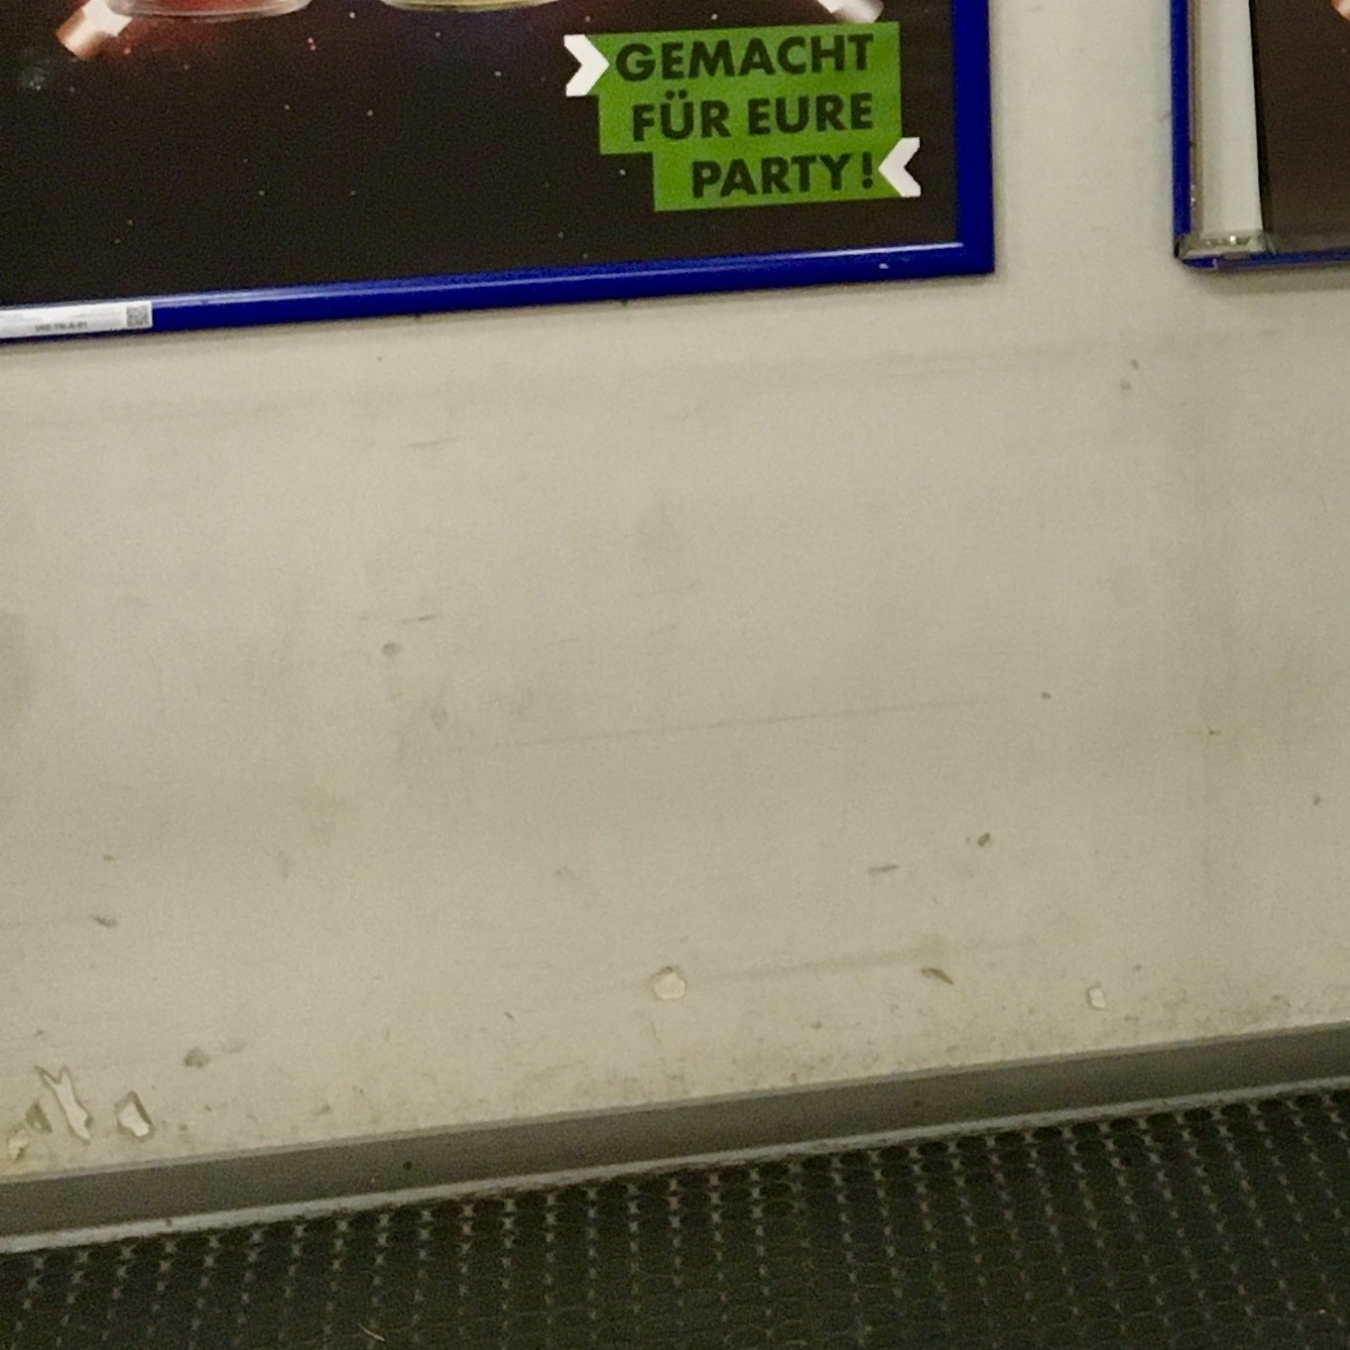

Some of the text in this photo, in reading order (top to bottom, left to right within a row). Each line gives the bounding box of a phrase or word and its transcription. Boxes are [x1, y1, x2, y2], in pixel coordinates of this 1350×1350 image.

[615, 33, 874, 82] GEMACHT
[632, 89, 874, 142] FÜR EURE
[691, 152, 875, 198] PARTY!
